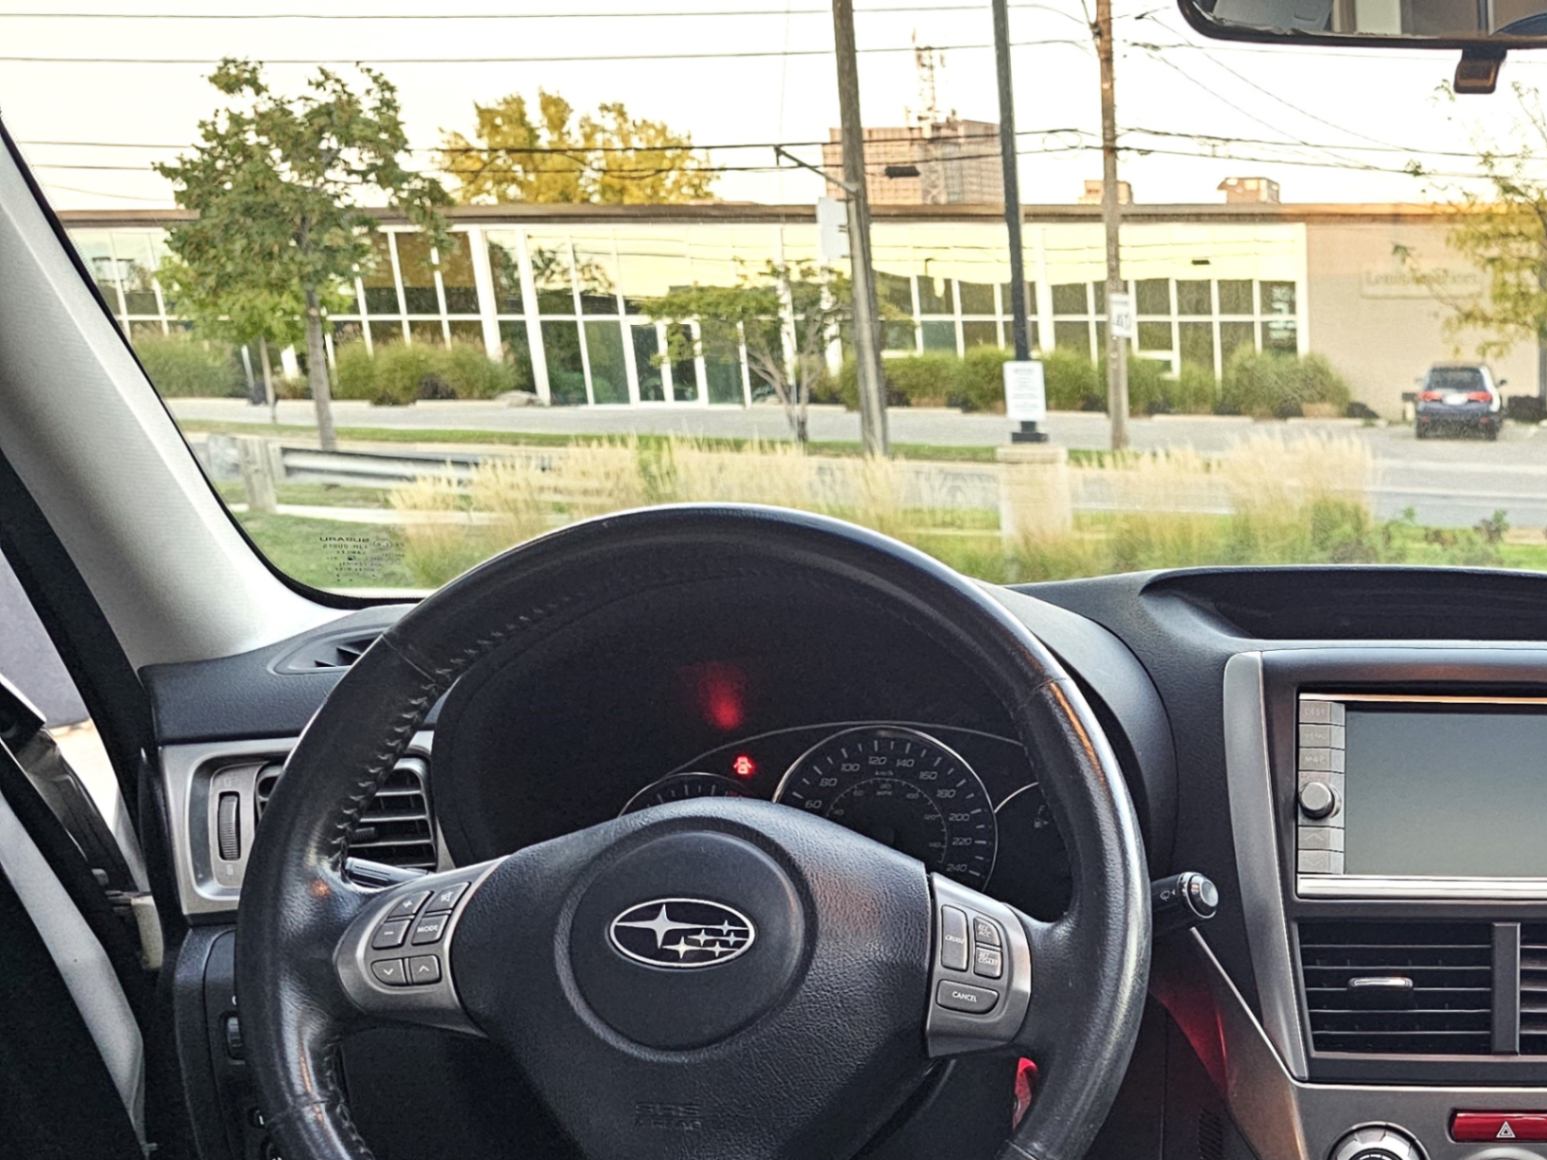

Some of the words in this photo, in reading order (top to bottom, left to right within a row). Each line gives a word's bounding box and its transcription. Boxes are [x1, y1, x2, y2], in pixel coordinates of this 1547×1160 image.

[868, 756, 887, 765] 120
[896, 759, 914, 768] 140
[841, 763, 860, 772] 100
[919, 771, 938, 780] 160
[819, 778, 837, 787] 80
[936, 789, 956, 798] 180
[805, 800, 822, 809] 60
[949, 813, 970, 821] 200
[952, 837, 972, 845] 220
[947, 863, 968, 872] 240
[417, 924, 438, 933] MODE
[952, 991, 977, 1003] CANCEL
